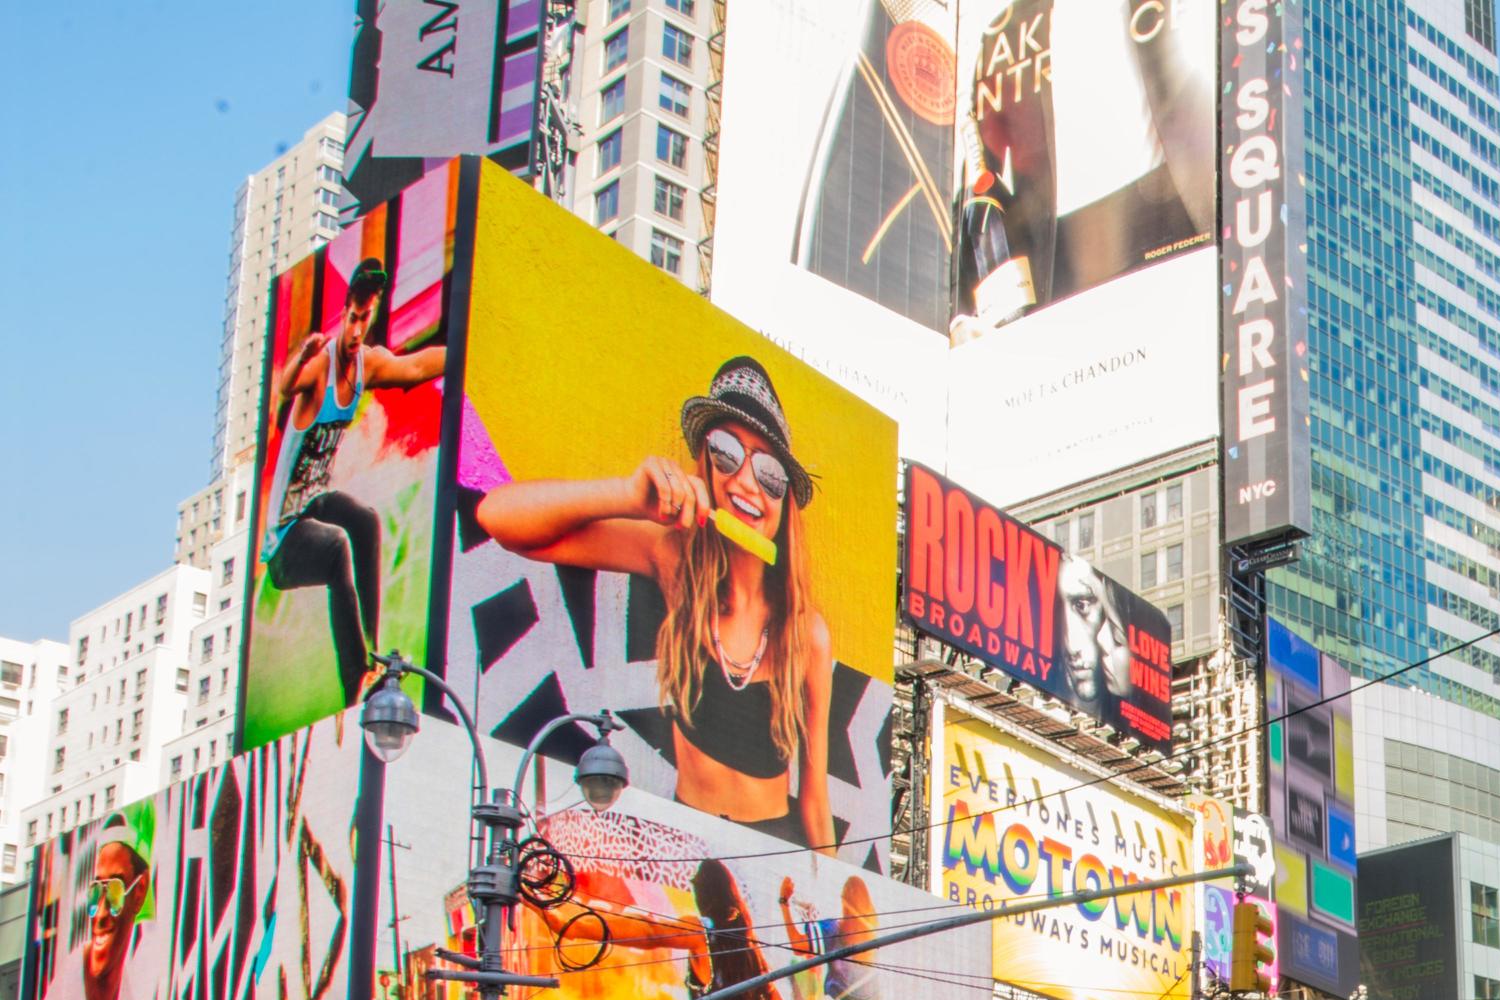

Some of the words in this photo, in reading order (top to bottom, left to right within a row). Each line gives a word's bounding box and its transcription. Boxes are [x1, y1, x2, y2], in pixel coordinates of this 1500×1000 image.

[1144, 246, 1174, 260] ROGER
[1174, 232, 1212, 250] FEDERER
[1230, 77, 1280, 442] SQUARE
[1062, 345, 1148, 389] CHANDON
[1239, 479, 1277, 505] NYC
[910, 465, 1061, 658] ROCKY
[909, 592, 1053, 682] BROADWAY
[1128, 623, 1170, 673] LOVE
[1129, 655, 1170, 704] WINS
[942, 800, 1183, 952] MOTOWN
[1099, 938, 1182, 982] MUSICAL
